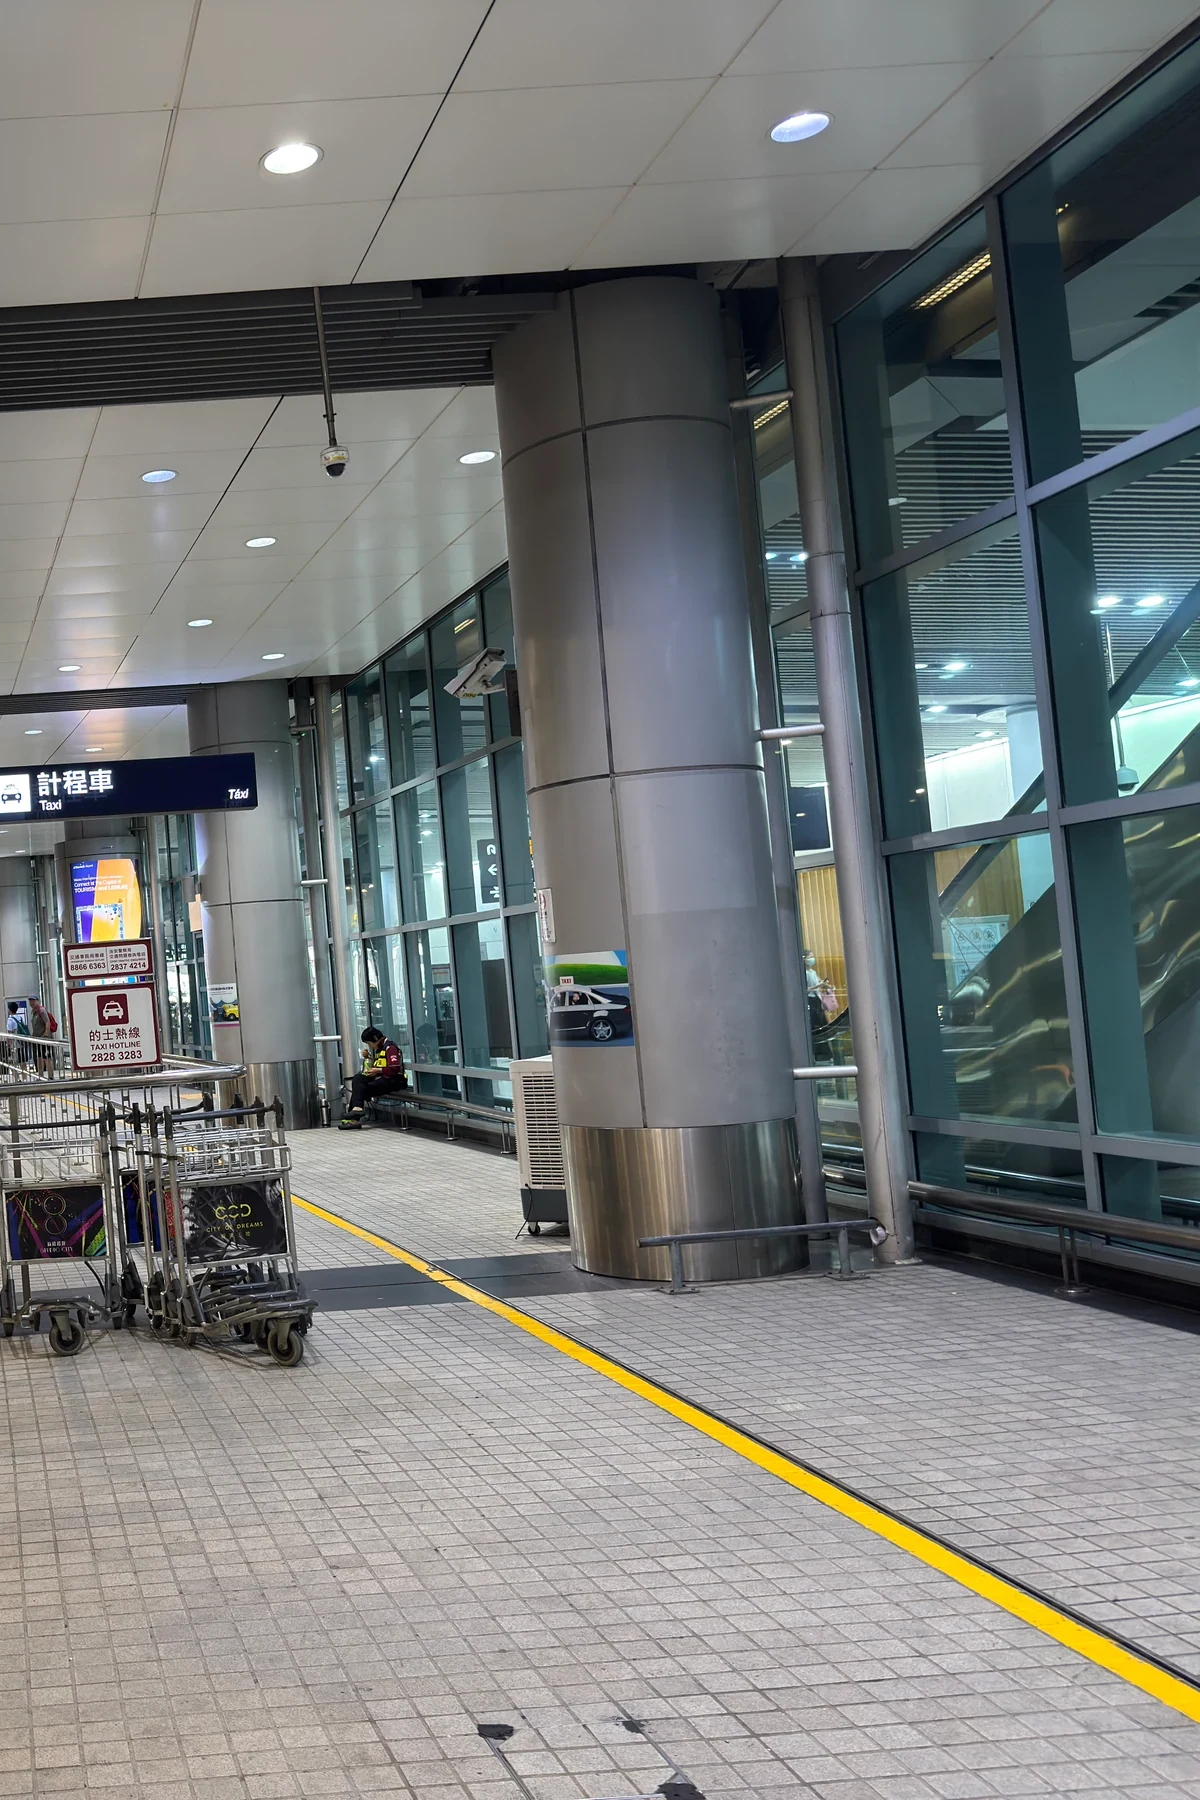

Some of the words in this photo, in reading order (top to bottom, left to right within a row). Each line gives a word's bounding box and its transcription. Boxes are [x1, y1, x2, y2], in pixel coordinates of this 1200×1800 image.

[36, 768, 114, 797] 計程車
[228, 788, 249, 800] Táxi
[39, 799, 62, 811] Taxi
[70, 963, 87, 971] 8866
[89, 962, 106, 970] 6363
[89, 1027, 140, 1042] 的士熱線
[109, 1041, 141, 1049] HOTLINE
[91, 1052, 115, 1062] 2828
[118, 1050, 142, 1060] 3283
[237, 1221, 263, 1229] DREAMS
